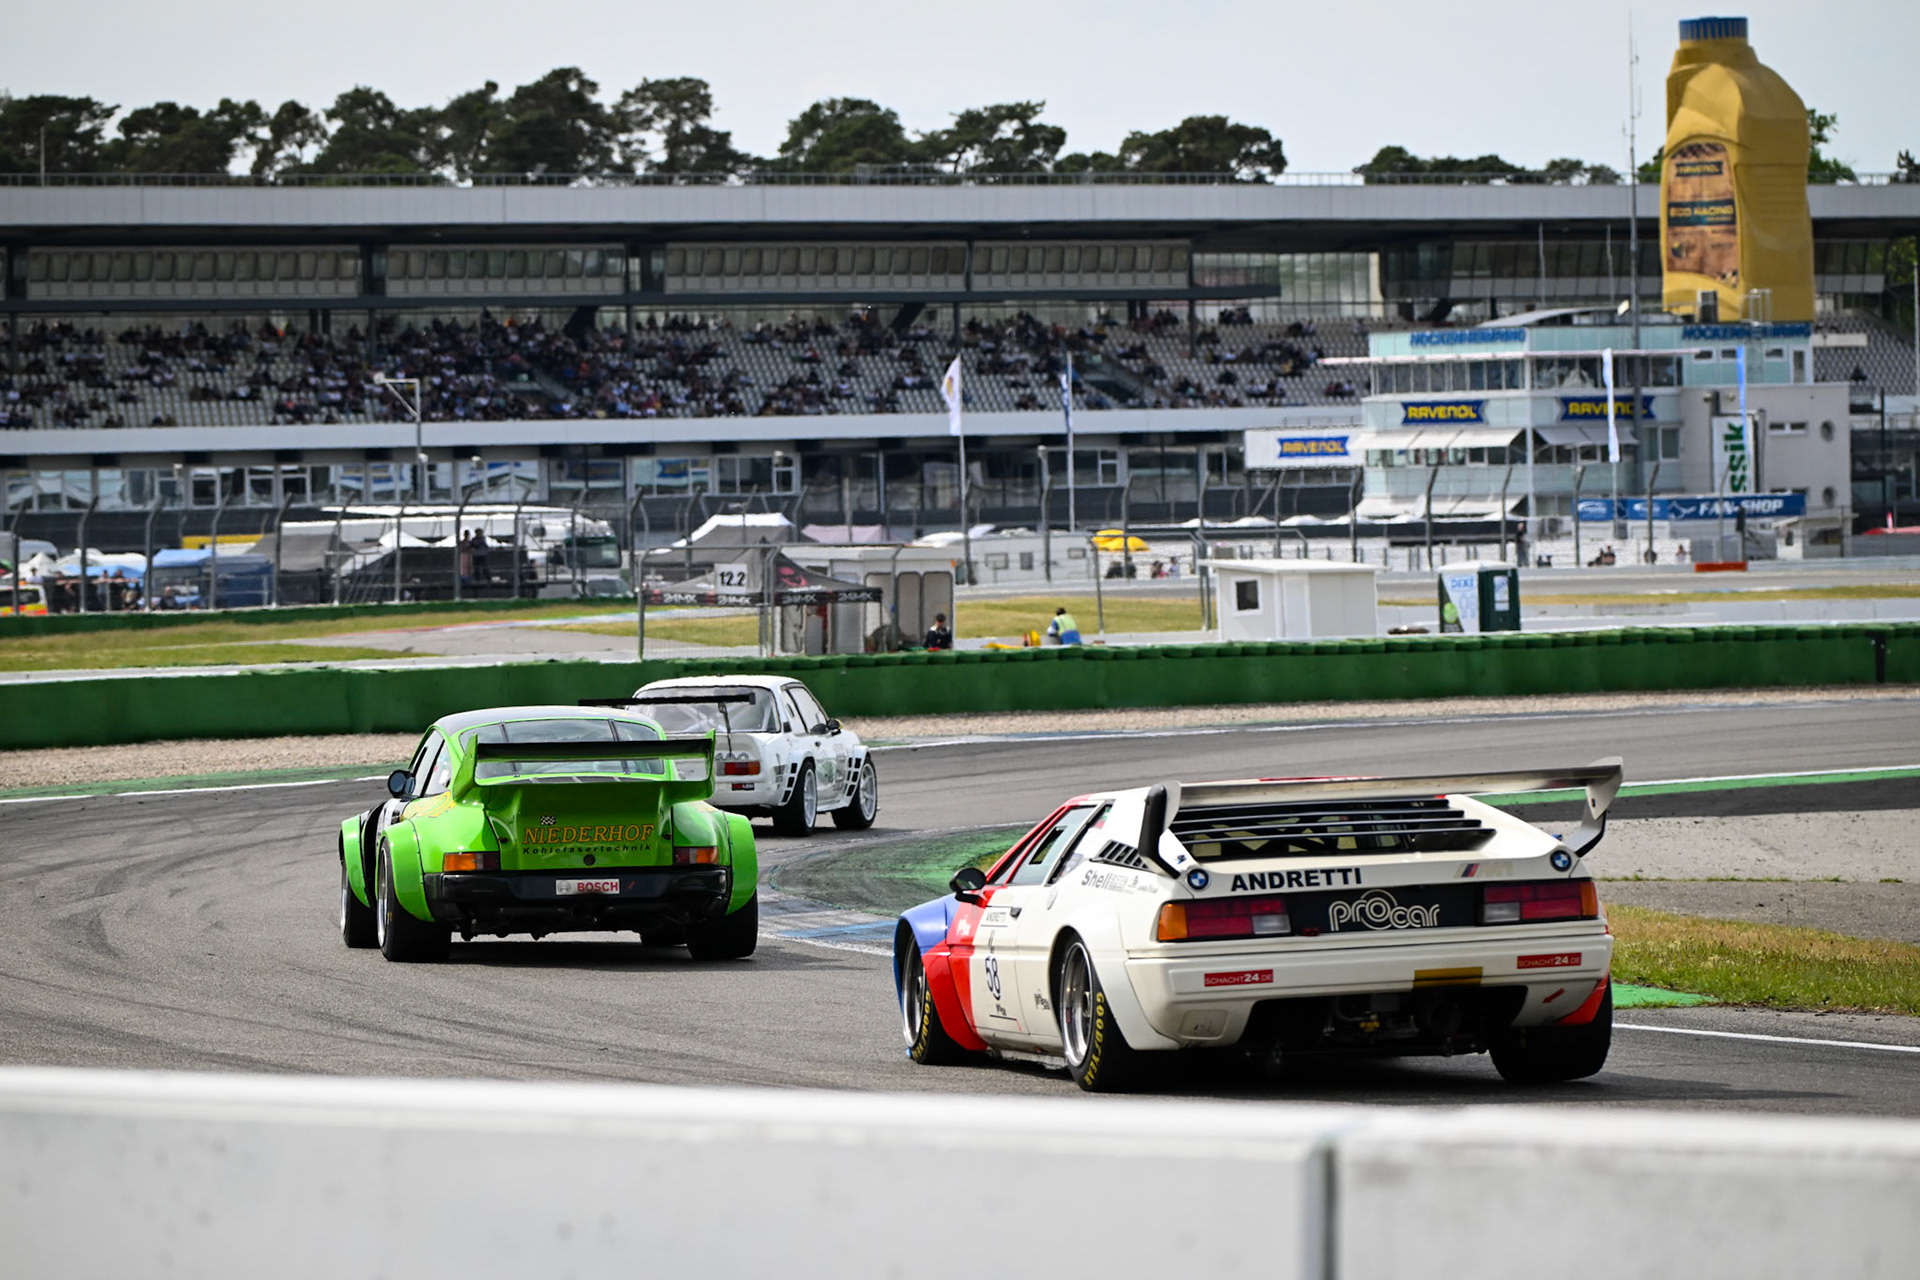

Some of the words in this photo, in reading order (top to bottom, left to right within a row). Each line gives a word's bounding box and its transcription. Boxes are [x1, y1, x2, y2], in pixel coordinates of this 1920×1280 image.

[1408, 405, 1477, 419] RAVENOL
[1568, 402, 1648, 415] RAVEN
[1282, 441, 1344, 453] RAVENOL
[720, 571, 746, 586] 12.2
[522, 824, 655, 845] NIEDERHOF
[522, 844, 652, 855] Kohlefasertechnik
[1081, 870, 1114, 889] Shell
[1231, 867, 1363, 892] ANDRETTI
[577, 882, 619, 892] BOSCH
[985, 956, 1001, 994] 58
[1205, 972, 1273, 985] SCHACHT24.DE
